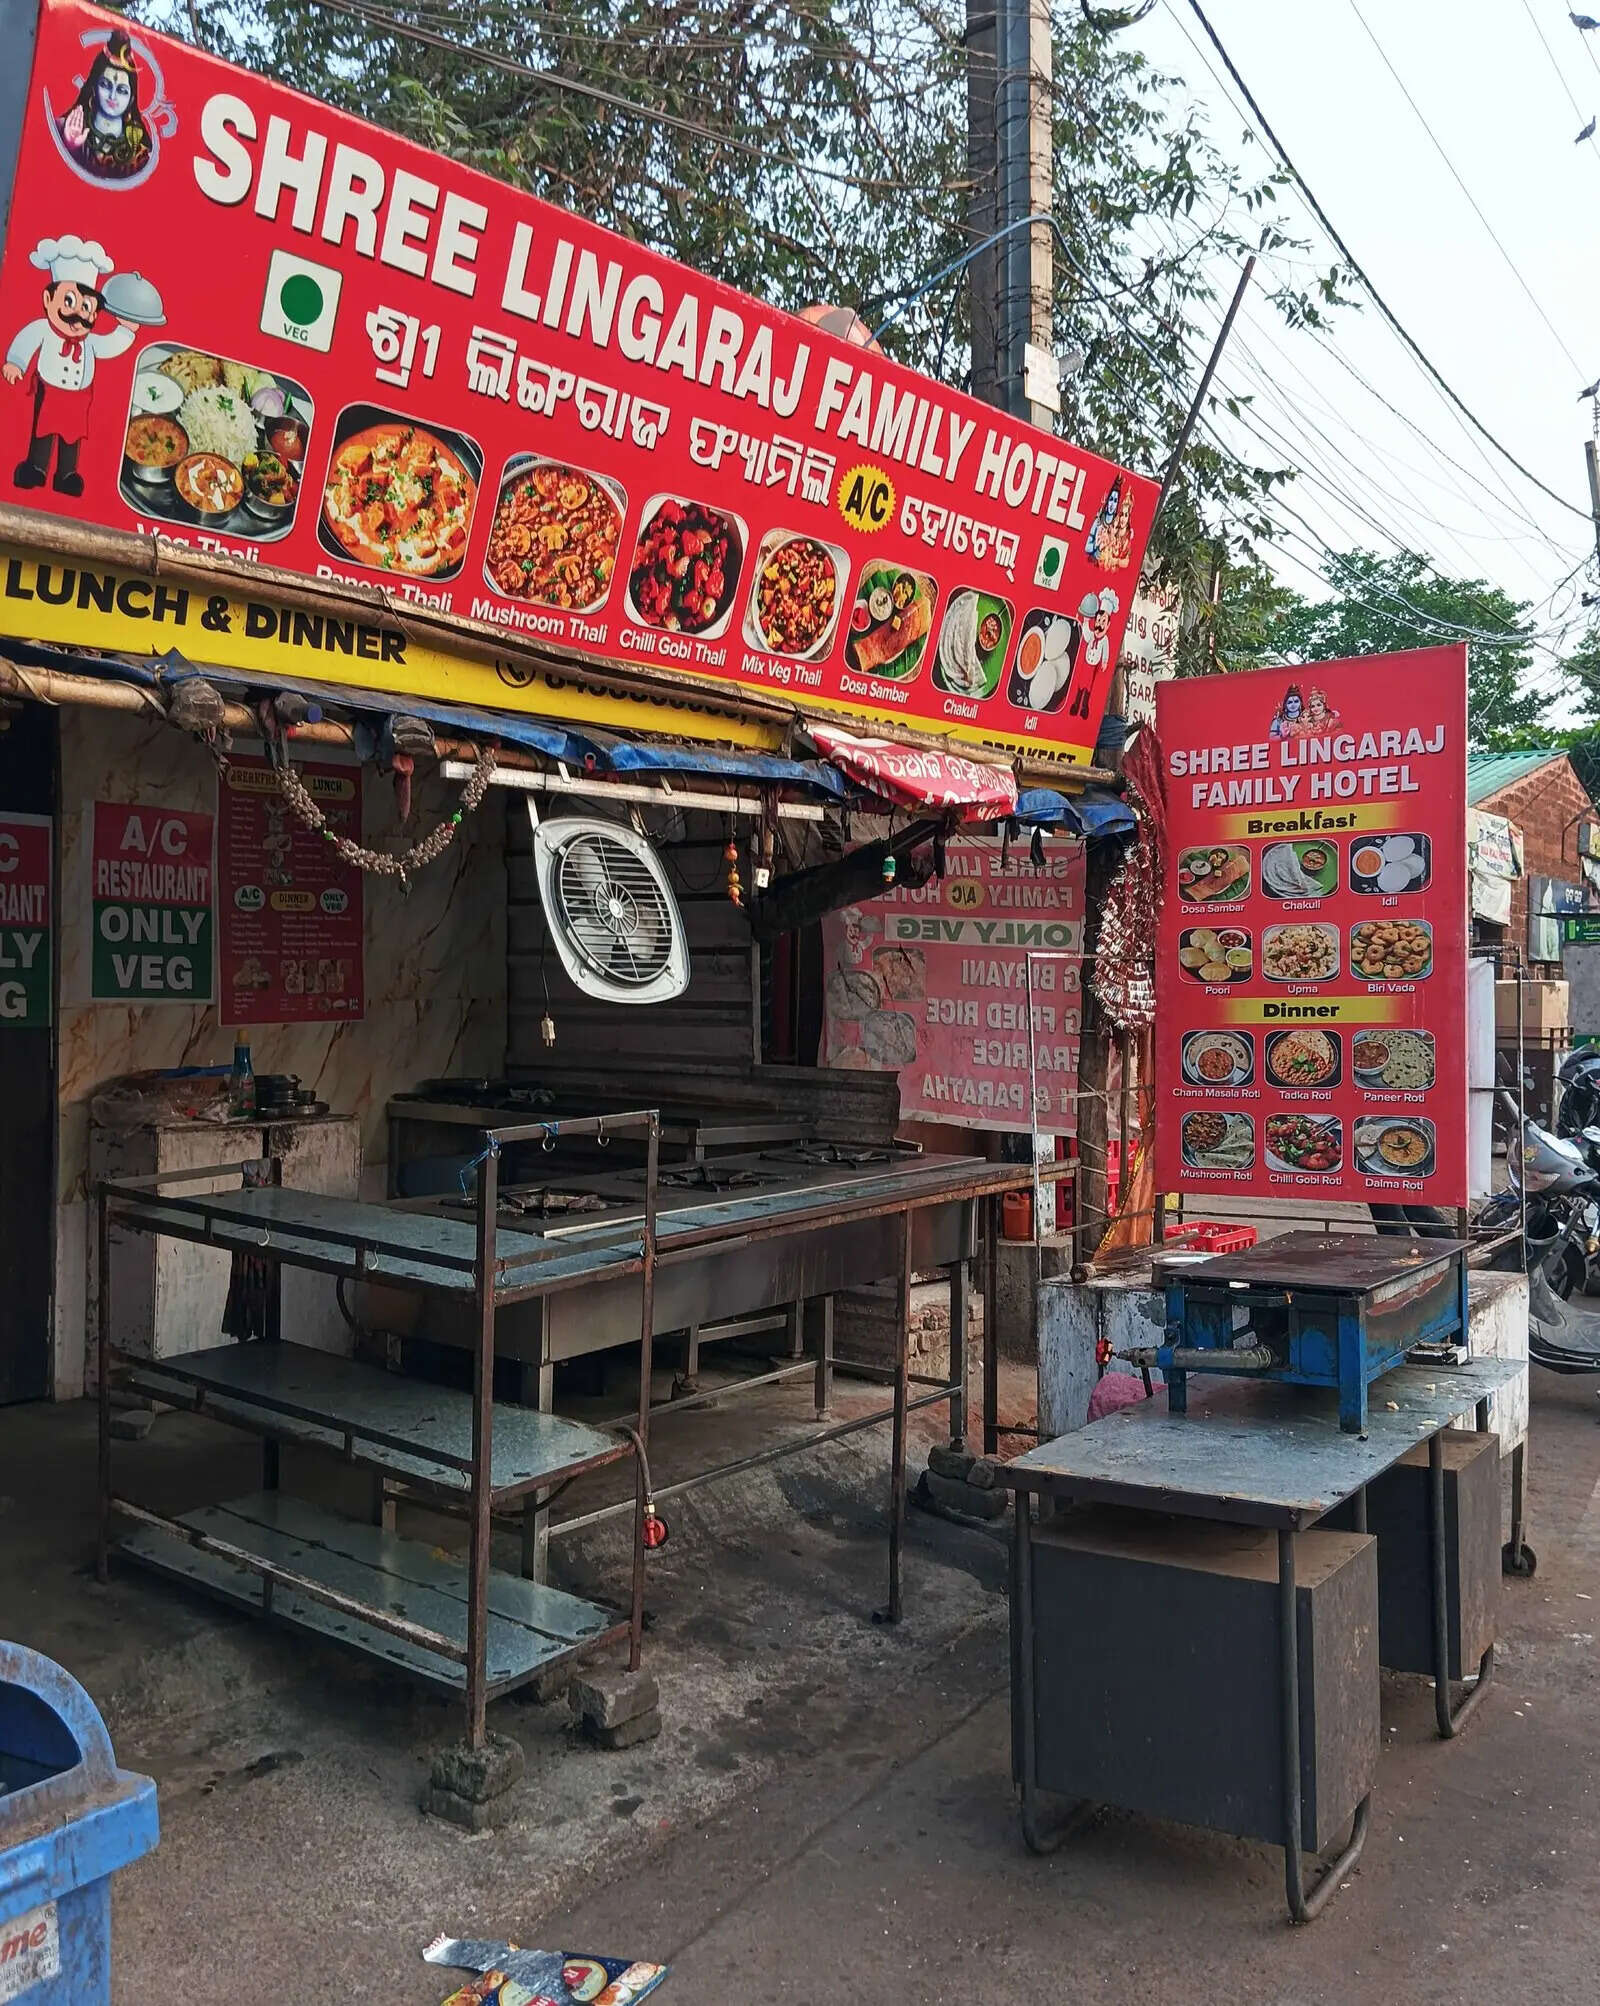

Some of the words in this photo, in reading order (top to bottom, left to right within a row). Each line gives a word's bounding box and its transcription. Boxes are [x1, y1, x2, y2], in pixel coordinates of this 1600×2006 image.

[194, 93, 488, 297] SHREE
[500, 222, 811, 419] LINGARAJ
[815, 357, 977, 485] FAMILY
[975, 428, 1087, 532] HOTEL
[283, 322, 309, 342] VEG
[846, 475, 890, 521] A/C
[5, 558, 190, 627] LUNCH
[200, 594, 233, 634] &
[245, 603, 408, 665] DINNER
[470, 597, 565, 636] Mushroom
[569, 616, 608, 644] Thali
[619, 627, 657, 652] Chilli
[657, 639, 692, 660] Gobi
[694, 643, 727, 667] Thali
[741, 652, 764, 674] Mix
[768, 661, 790, 682] Veg
[791, 667, 823, 688] Thali
[839, 675, 868, 696] Dosa
[869, 683, 910, 705] Sambar
[943, 698, 980, 720] Chakuli
[1024, 715, 1038, 731] Idli
[1170, 742, 1270, 776] SHREE
[1279, 725, 1445, 767] LINGARAJ
[1192, 775, 1301, 809] FAMILY
[1310, 764, 1419, 799] HOTEL
[1247, 811, 1358, 834] Breakfast
[120, 815, 188, 857] A/C
[97, 859, 208, 903] RESTAURANT
[240, 888, 260, 900] A/C
[1382, 896, 1399, 907] Idli
[1181, 905, 1206, 914] Dosa
[1207, 903, 1246, 914] Sambar
[1282, 900, 1321, 911] Chakuli
[100, 906, 206, 945] ONLY
[112, 953, 194, 991] VEG
[1205, 985, 1231, 996] Poori
[1287, 985, 1318, 996] Upma
[1367, 983, 1387, 993] Biri
[1387, 983, 1416, 993] Vada
[1263, 1002, 1340, 1018] Dinner
[1172, 1088, 1204, 1098] Chana
[1205, 1088, 1240, 1098] Masala
[1241, 1088, 1261, 1098] Roti
[1279, 1090, 1310, 1100] Tadka
[1311, 1090, 1332, 1100] Roti
[1363, 1091, 1402, 1102] Paneer
[1403, 1092, 1425, 1103] Roti
[1180, 1169, 1232, 1180] Mushroom
[1233, 1170, 1253, 1181] Roti
[1268, 1173, 1294, 1185] Chilli
[1295, 1174, 1320, 1185] Gobi
[1321, 1175, 1342, 1186] Roti
[1364, 1177, 1401, 1189] Dalma
[1402, 1179, 1424, 1190] Roti
[0, 1922, 47, 1965] me
